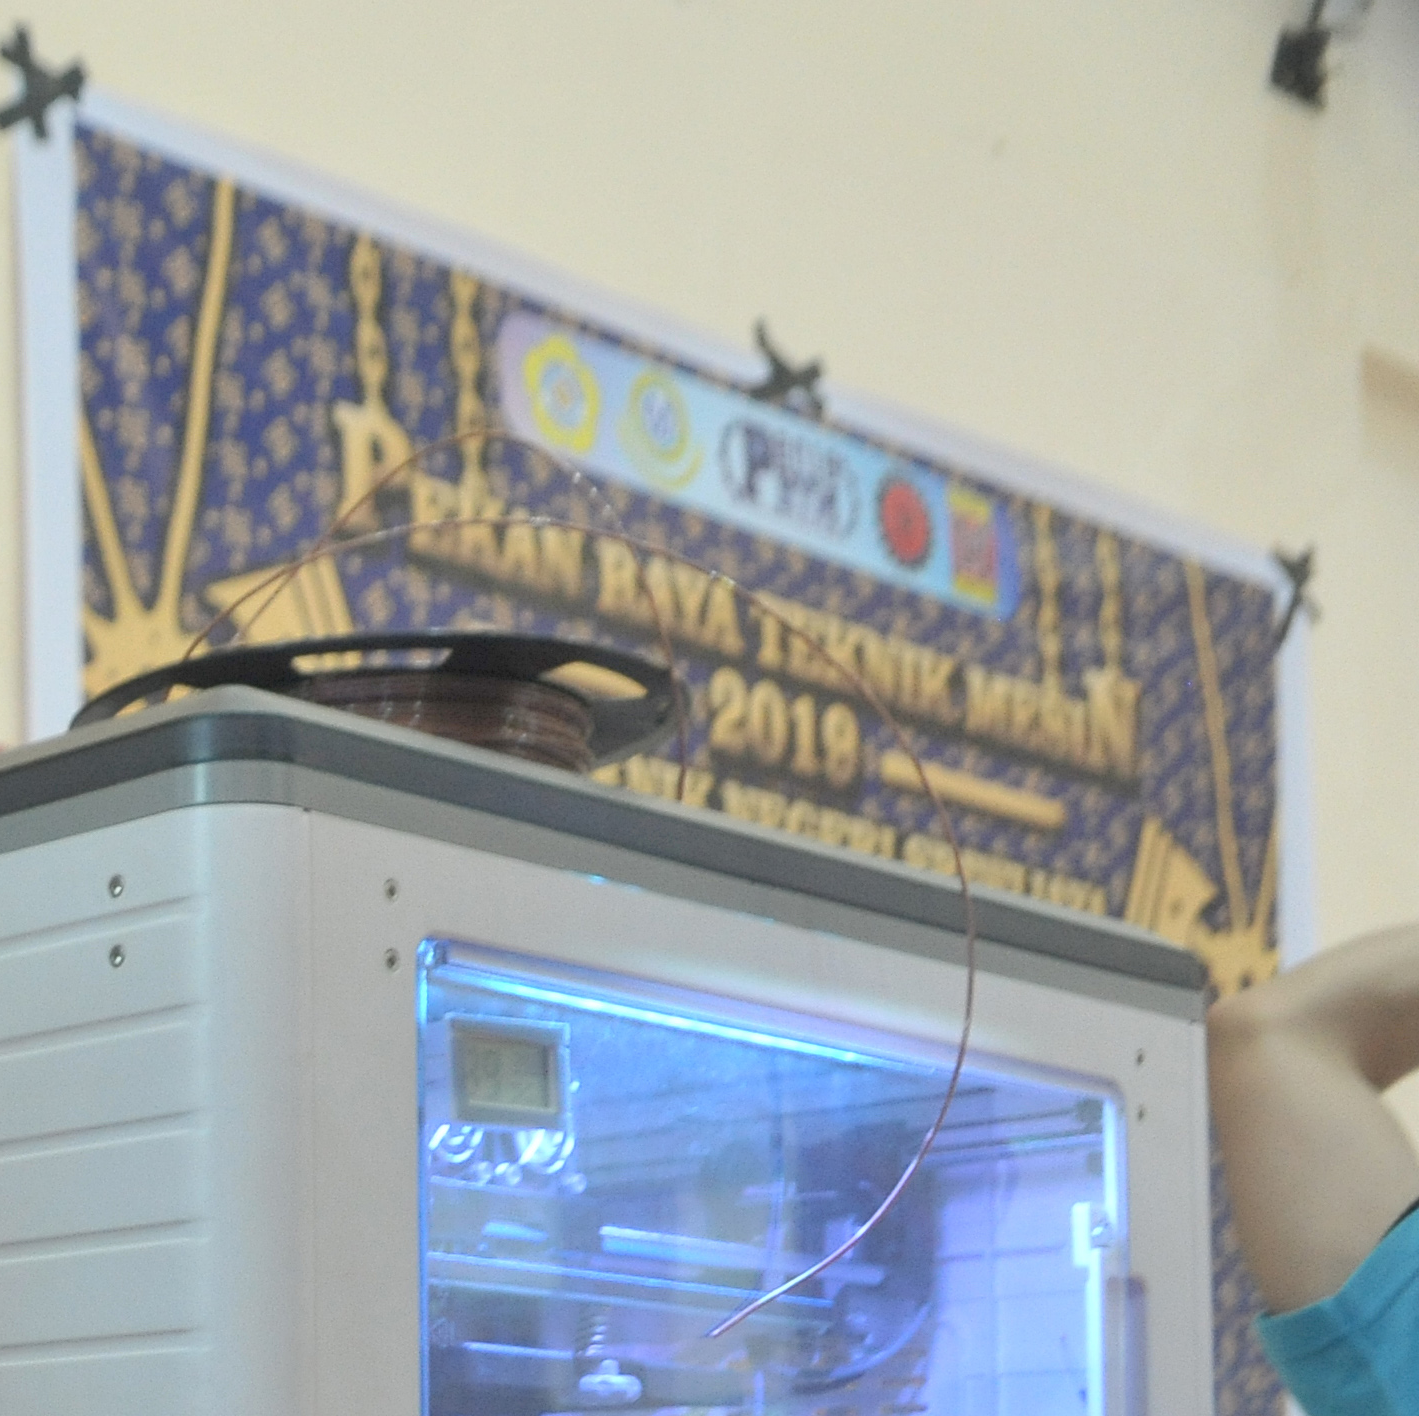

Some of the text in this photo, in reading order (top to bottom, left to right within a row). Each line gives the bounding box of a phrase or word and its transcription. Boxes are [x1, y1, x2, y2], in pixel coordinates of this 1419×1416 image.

[596, 534, 745, 659] RAYA
[748, 590, 965, 724] TEKNIK
[965, 662, 1143, 779] MESIN
